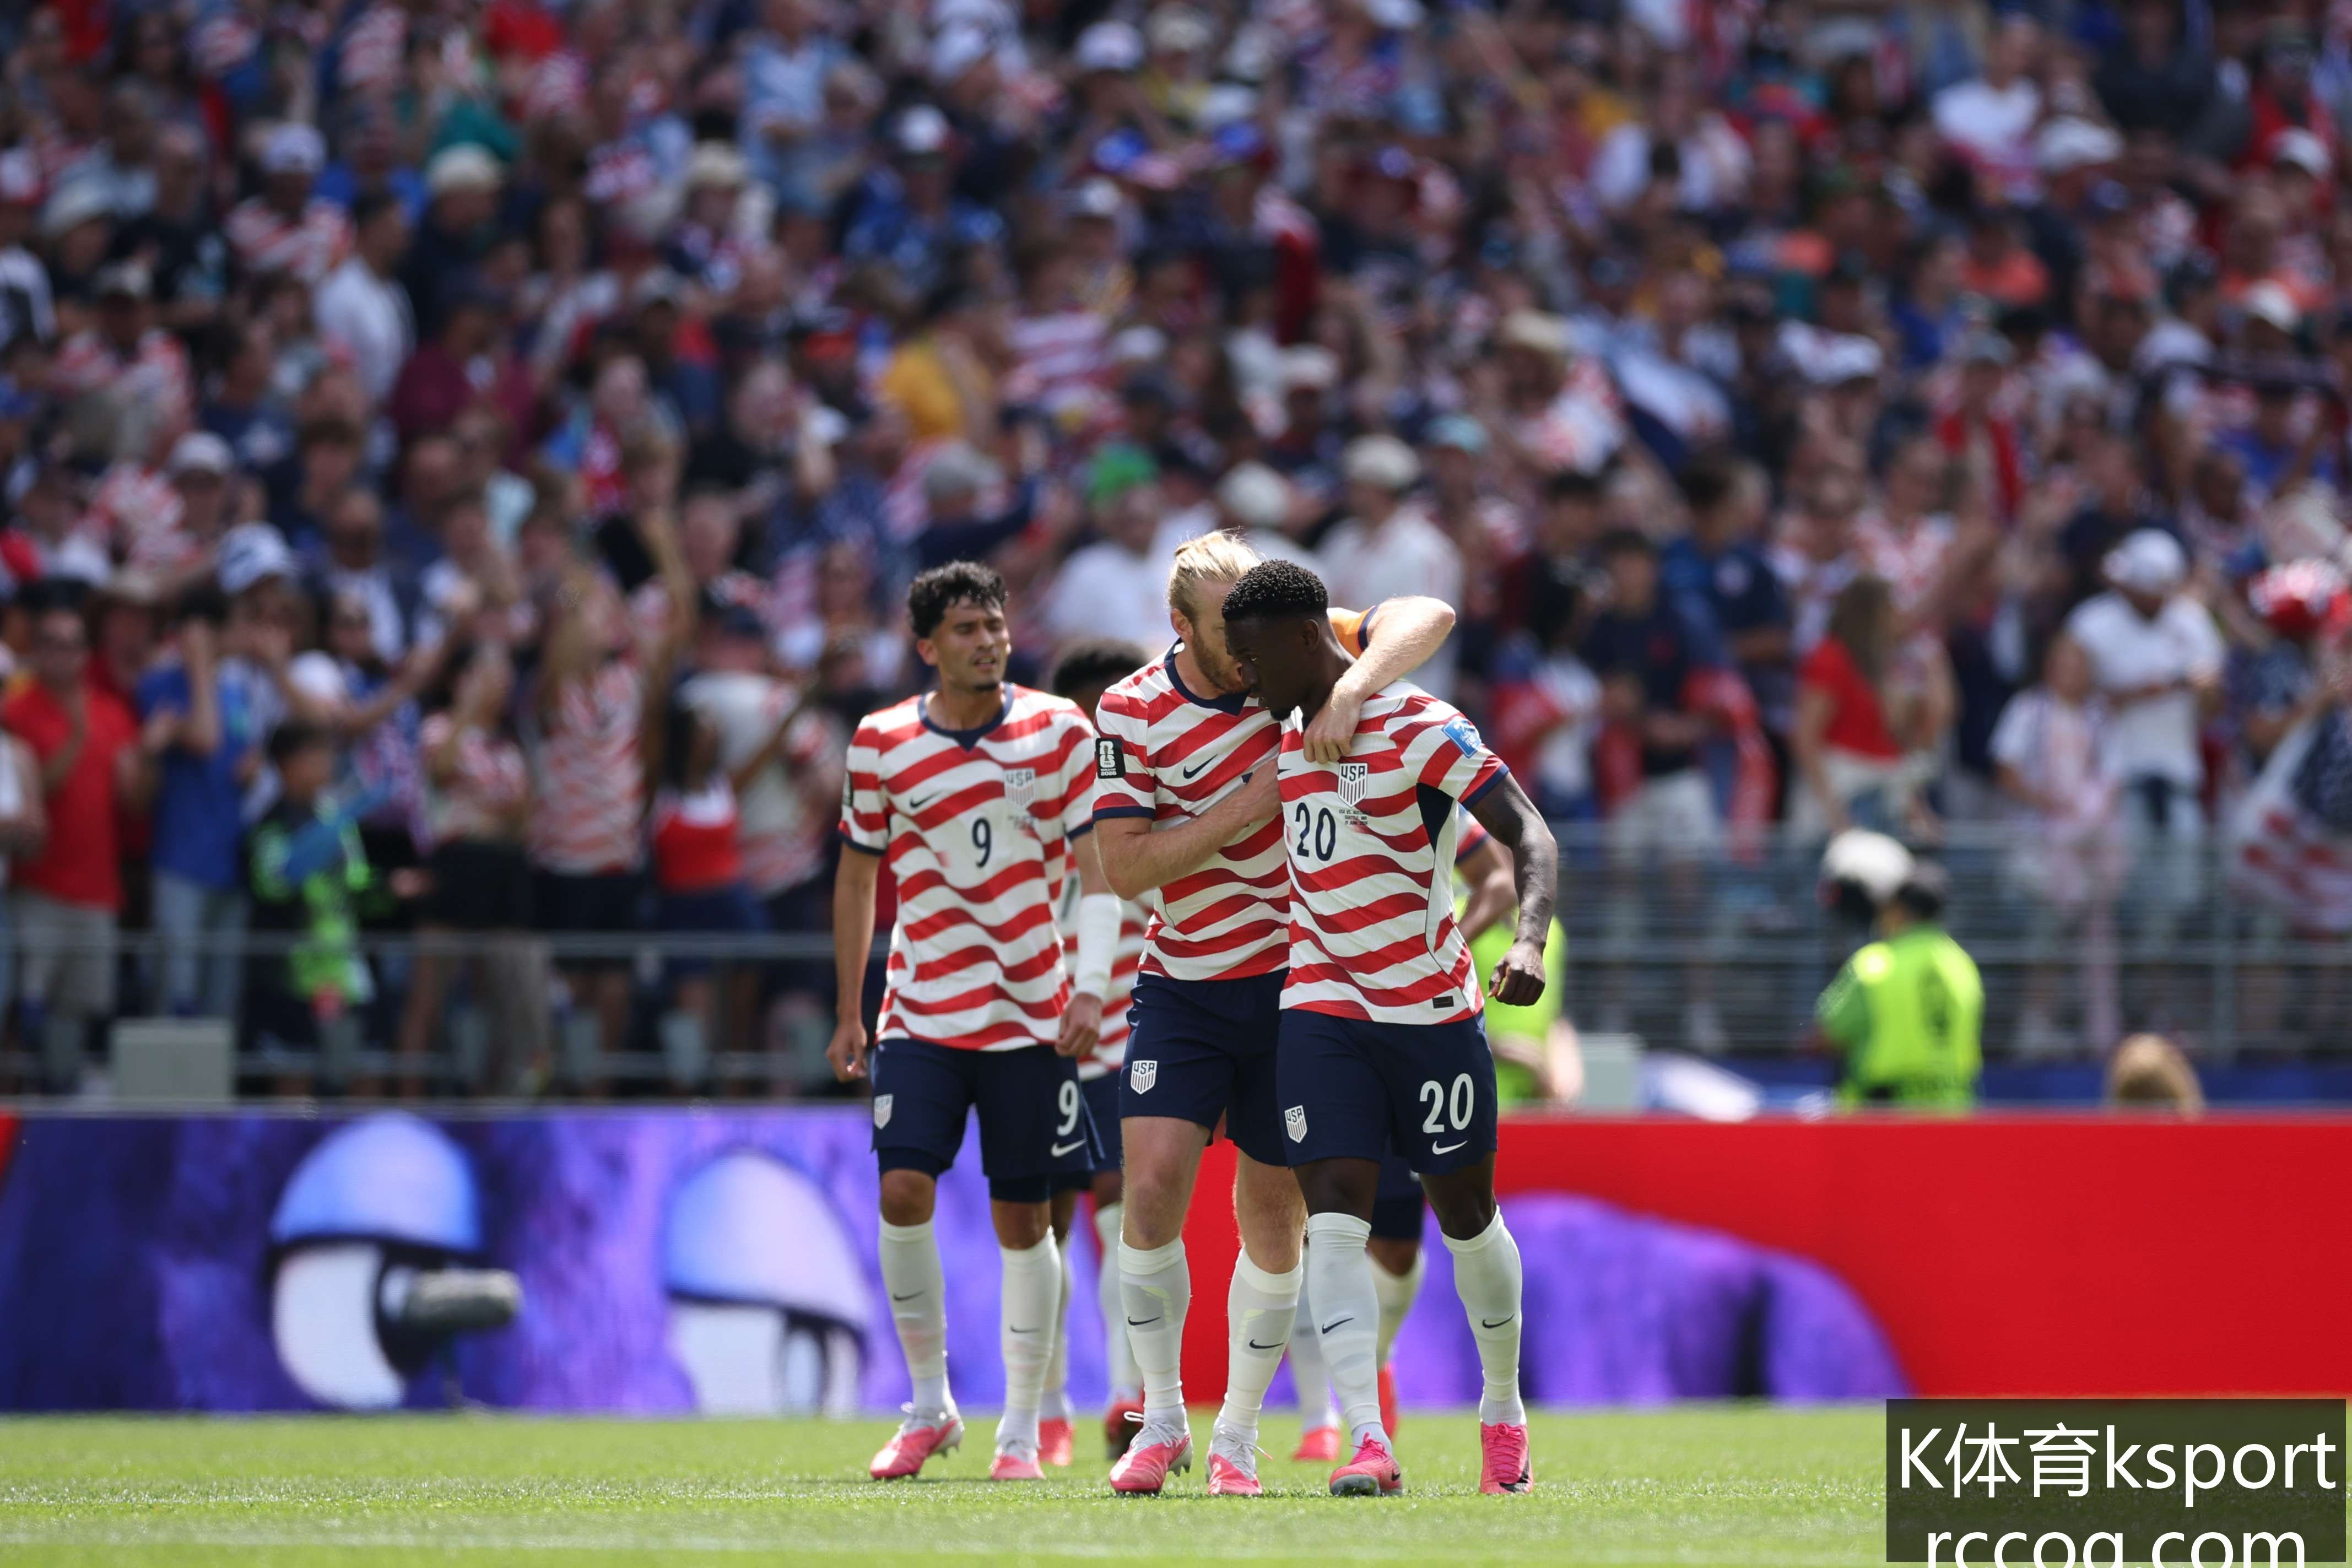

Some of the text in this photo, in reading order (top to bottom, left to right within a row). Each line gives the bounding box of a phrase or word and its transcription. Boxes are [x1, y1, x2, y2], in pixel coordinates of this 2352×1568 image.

[1006, 771, 1032, 786] USA
[1341, 765, 1365, 781] USA
[971, 817, 991, 868] 9
[1295, 802, 1335, 861] 20
[1133, 1062, 1155, 1074] USA
[1057, 1080, 1078, 1136] 9
[1286, 1107, 1302, 1123] USA
[1420, 1073, 1474, 1133] 20
